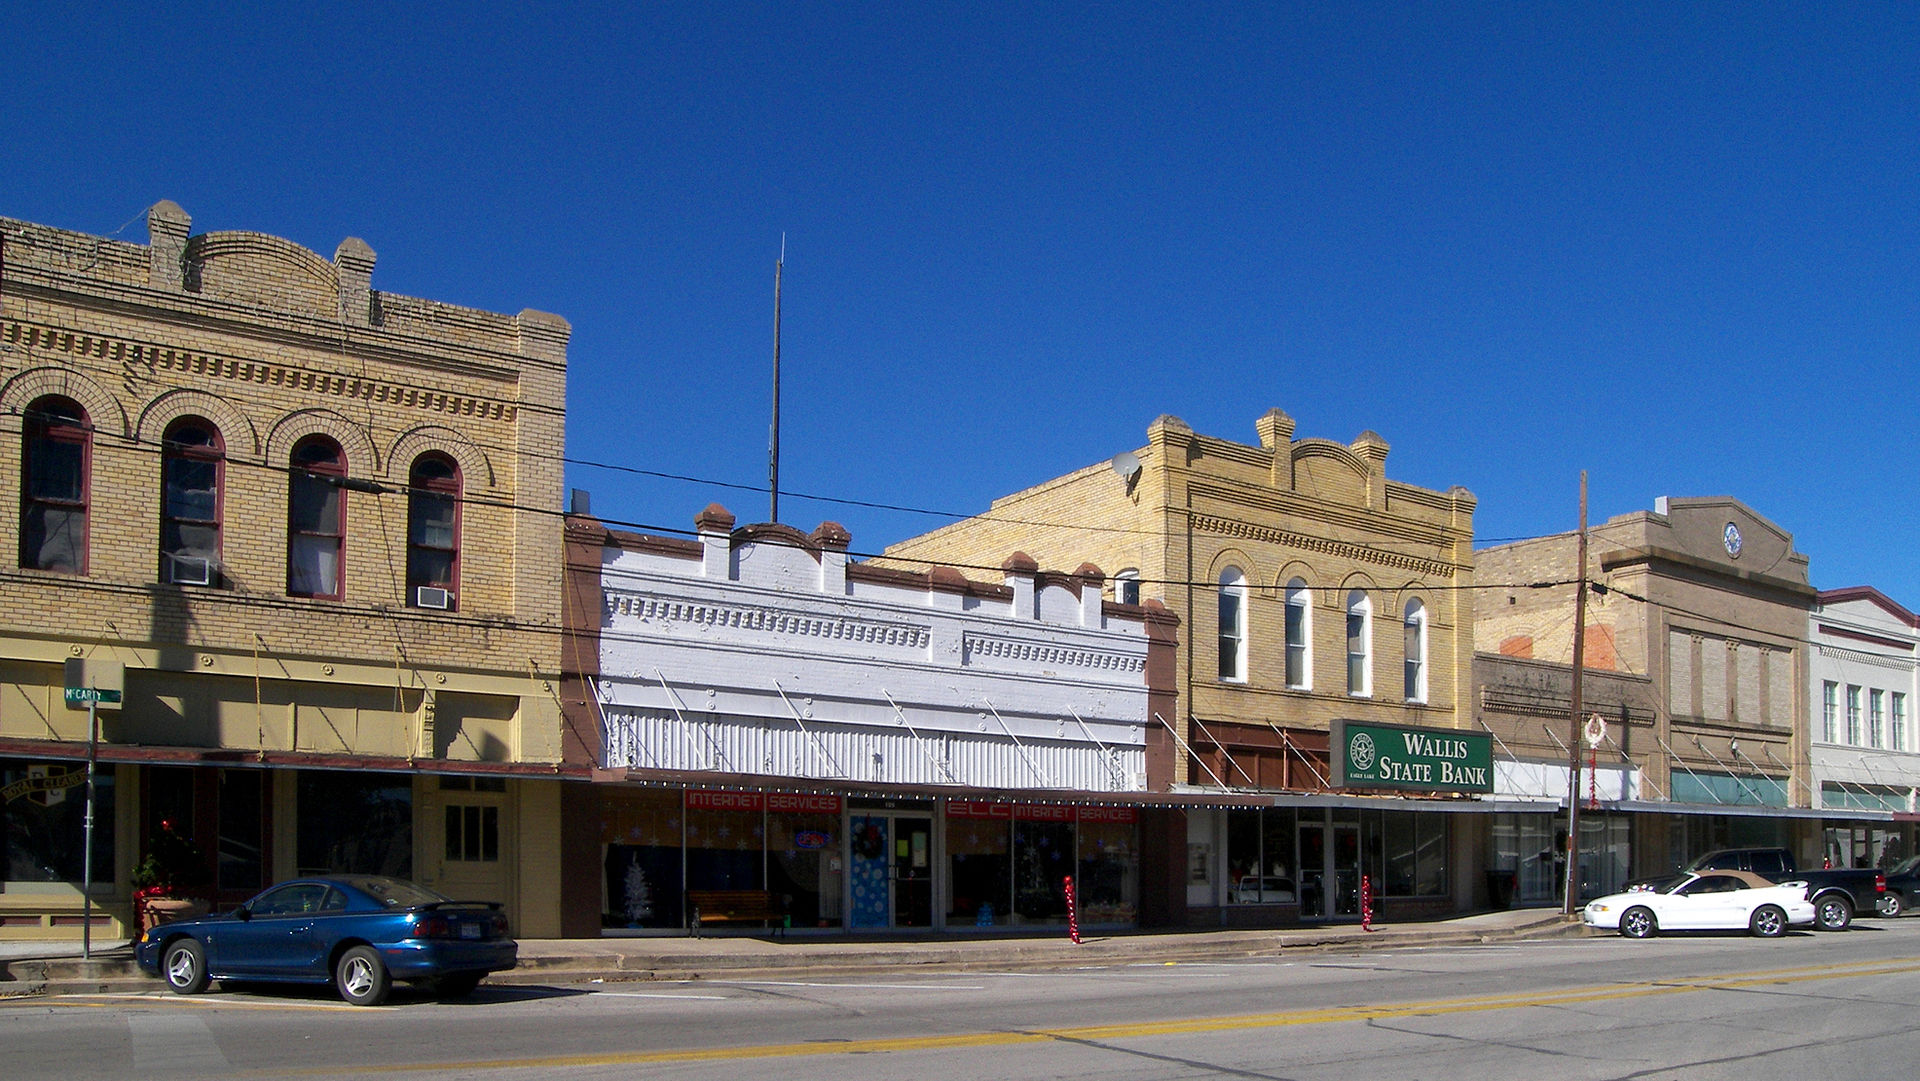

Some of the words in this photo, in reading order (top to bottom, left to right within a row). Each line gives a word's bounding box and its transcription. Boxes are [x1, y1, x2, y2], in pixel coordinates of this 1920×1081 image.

[1402, 733, 1468, 759] WALLIS
[1379, 756, 1432, 782] STATE
[1440, 761, 1486, 785] BANK
[689, 792, 761, 807] INTERNET
[769, 795, 838, 810] SERVICES
[947, 802, 1009, 817] ELC
[1015, 805, 1070, 818] INTERNET
[1079, 808, 1133, 821] SERVICES
